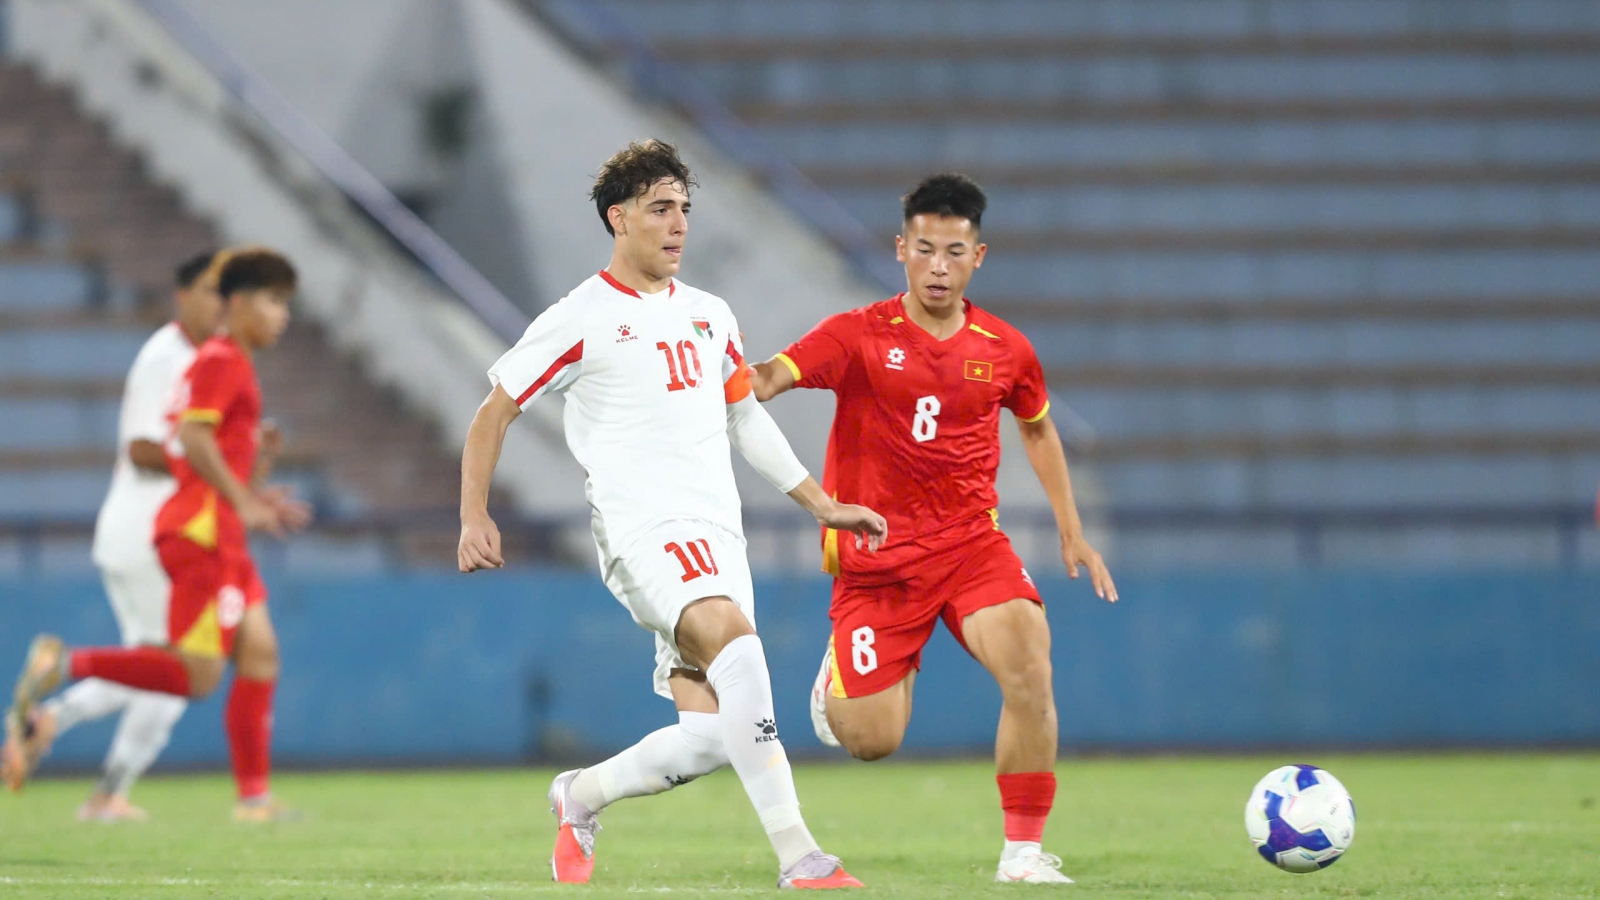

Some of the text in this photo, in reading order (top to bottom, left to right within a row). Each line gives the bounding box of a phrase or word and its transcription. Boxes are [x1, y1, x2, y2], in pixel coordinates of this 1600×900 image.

[615, 335, 639, 343] KELME
[656, 340, 704, 392] 10
[911, 395, 941, 442] 8
[664, 538, 719, 583] 10
[851, 625, 877, 675] 8
